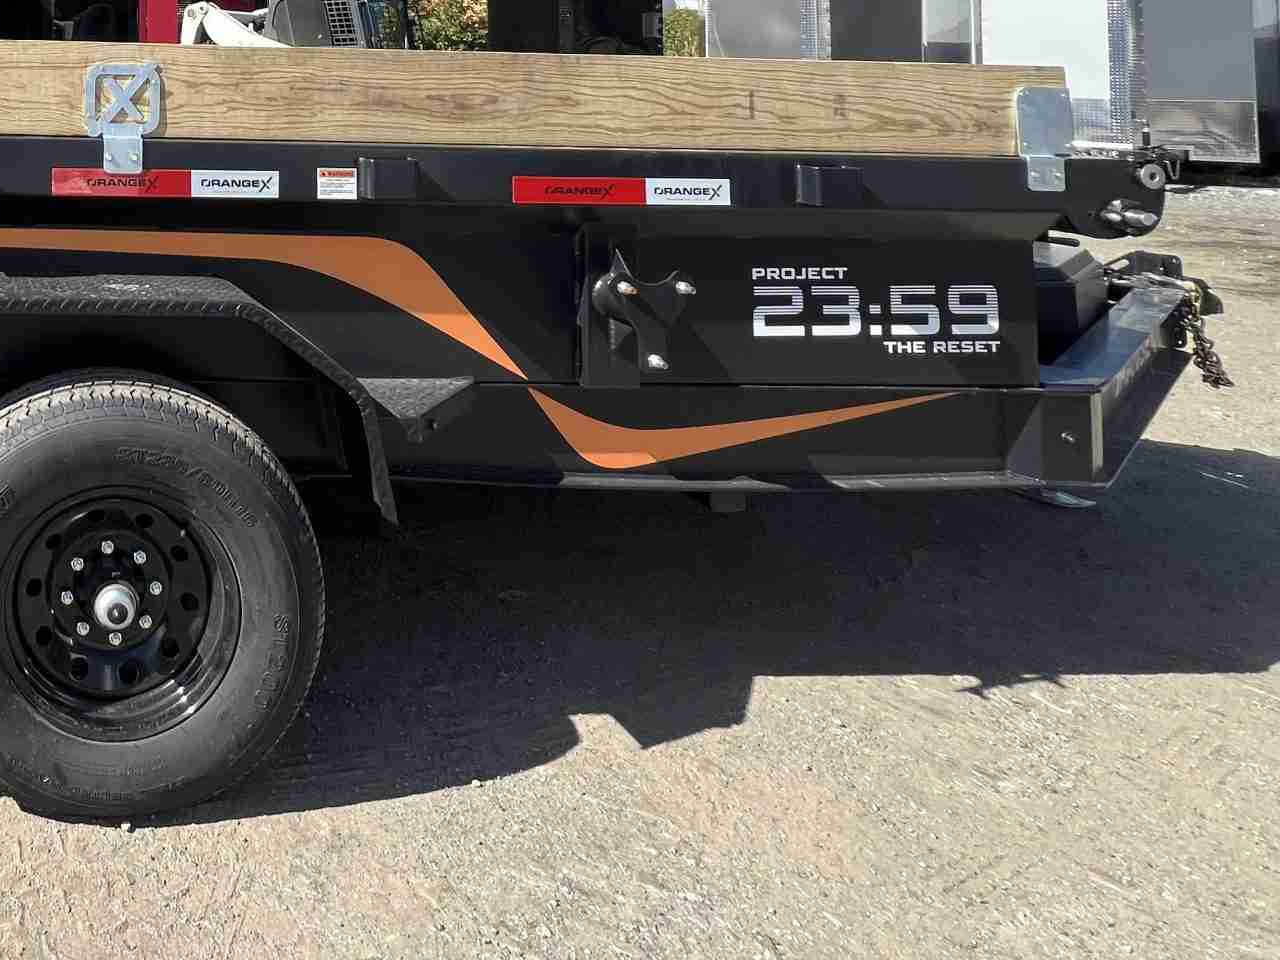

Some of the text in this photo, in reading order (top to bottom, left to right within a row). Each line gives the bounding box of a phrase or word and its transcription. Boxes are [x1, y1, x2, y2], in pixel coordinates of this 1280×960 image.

[86, 176, 160, 193] ORANGEX
[200, 176, 273, 193] ORANGEX
[654, 184, 723, 201] ORANGEX
[751, 267, 848, 281] PROJECT
[752, 285, 1000, 337] 23:59
[882, 341, 1001, 354] THE RESET
